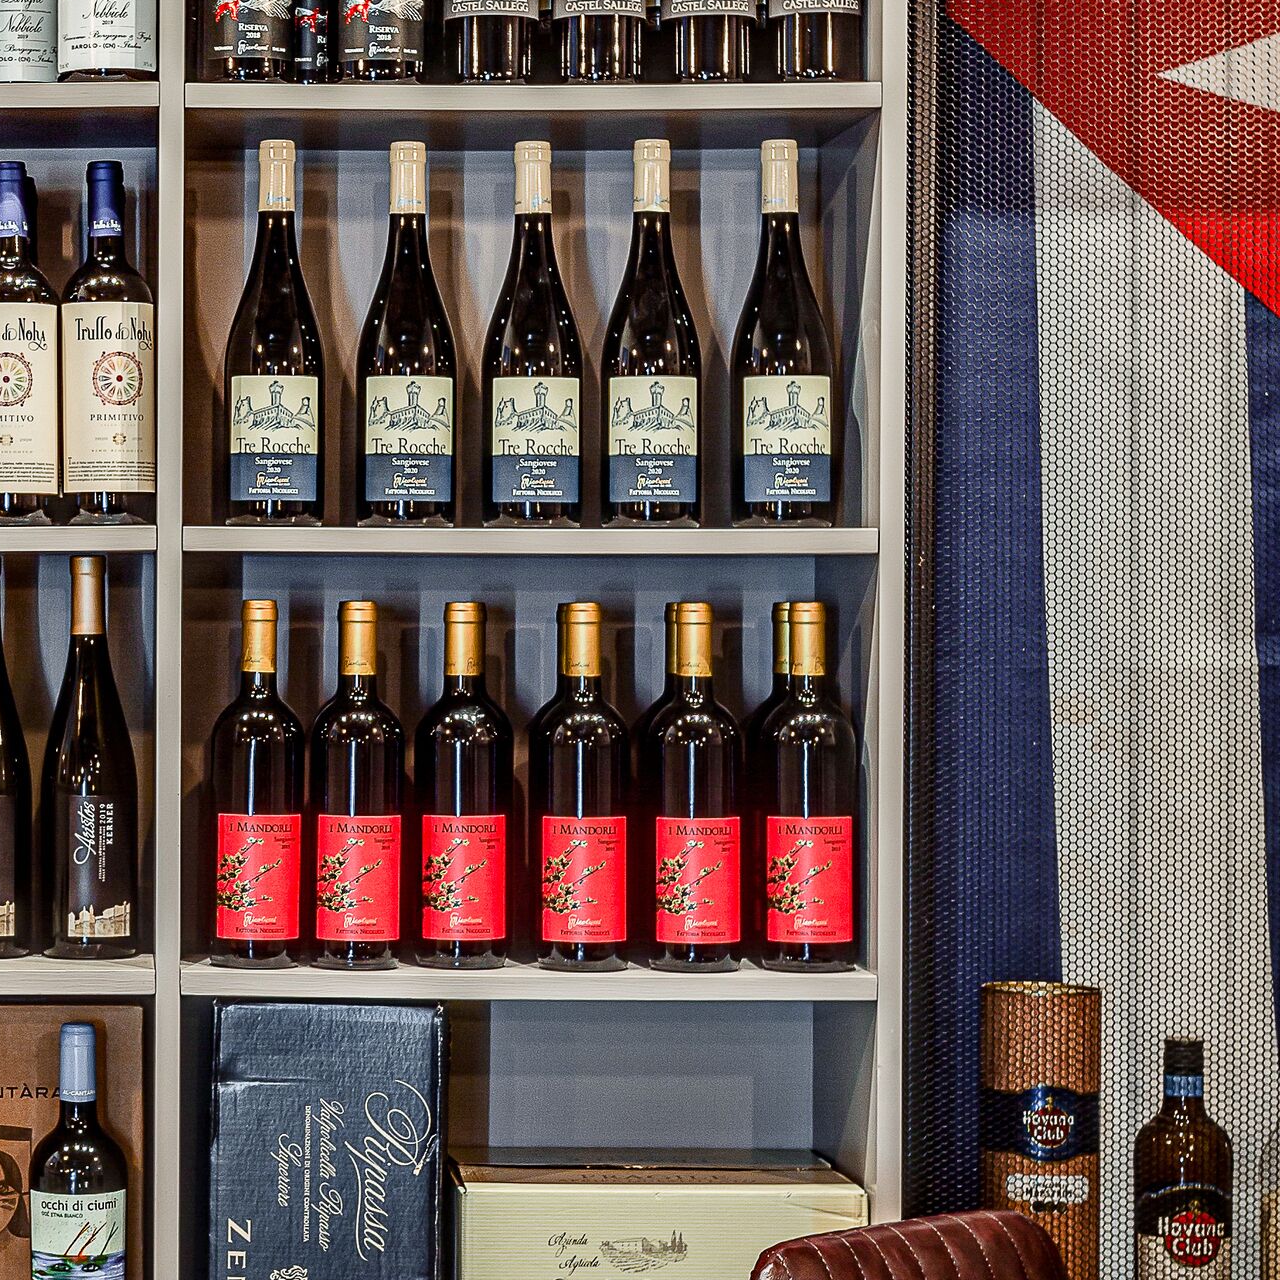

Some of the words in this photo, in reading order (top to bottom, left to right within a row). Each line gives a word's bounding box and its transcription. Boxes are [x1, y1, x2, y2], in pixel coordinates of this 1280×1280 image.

[451, 0, 484, 12] CASTEL
[486, 0, 529, 12] SALLEGG
[236, 437, 257, 455] Tre
[260, 437, 311, 455] Rocche
[255, 457, 293, 467] Sangiovese
[237, 822, 292, 834] MANDORLI
[312, 1097, 345, 1181] Valpolicella
[271, 1133, 302, 1207] Superiore
[312, 1182, 343, 1252] Ripasso
[1157, 1217, 1226, 1239] Havana
[548, 1232, 589, 1257] Azienda
[1171, 1237, 1214, 1257] Club
[559, 1255, 600, 1276] Agricola
